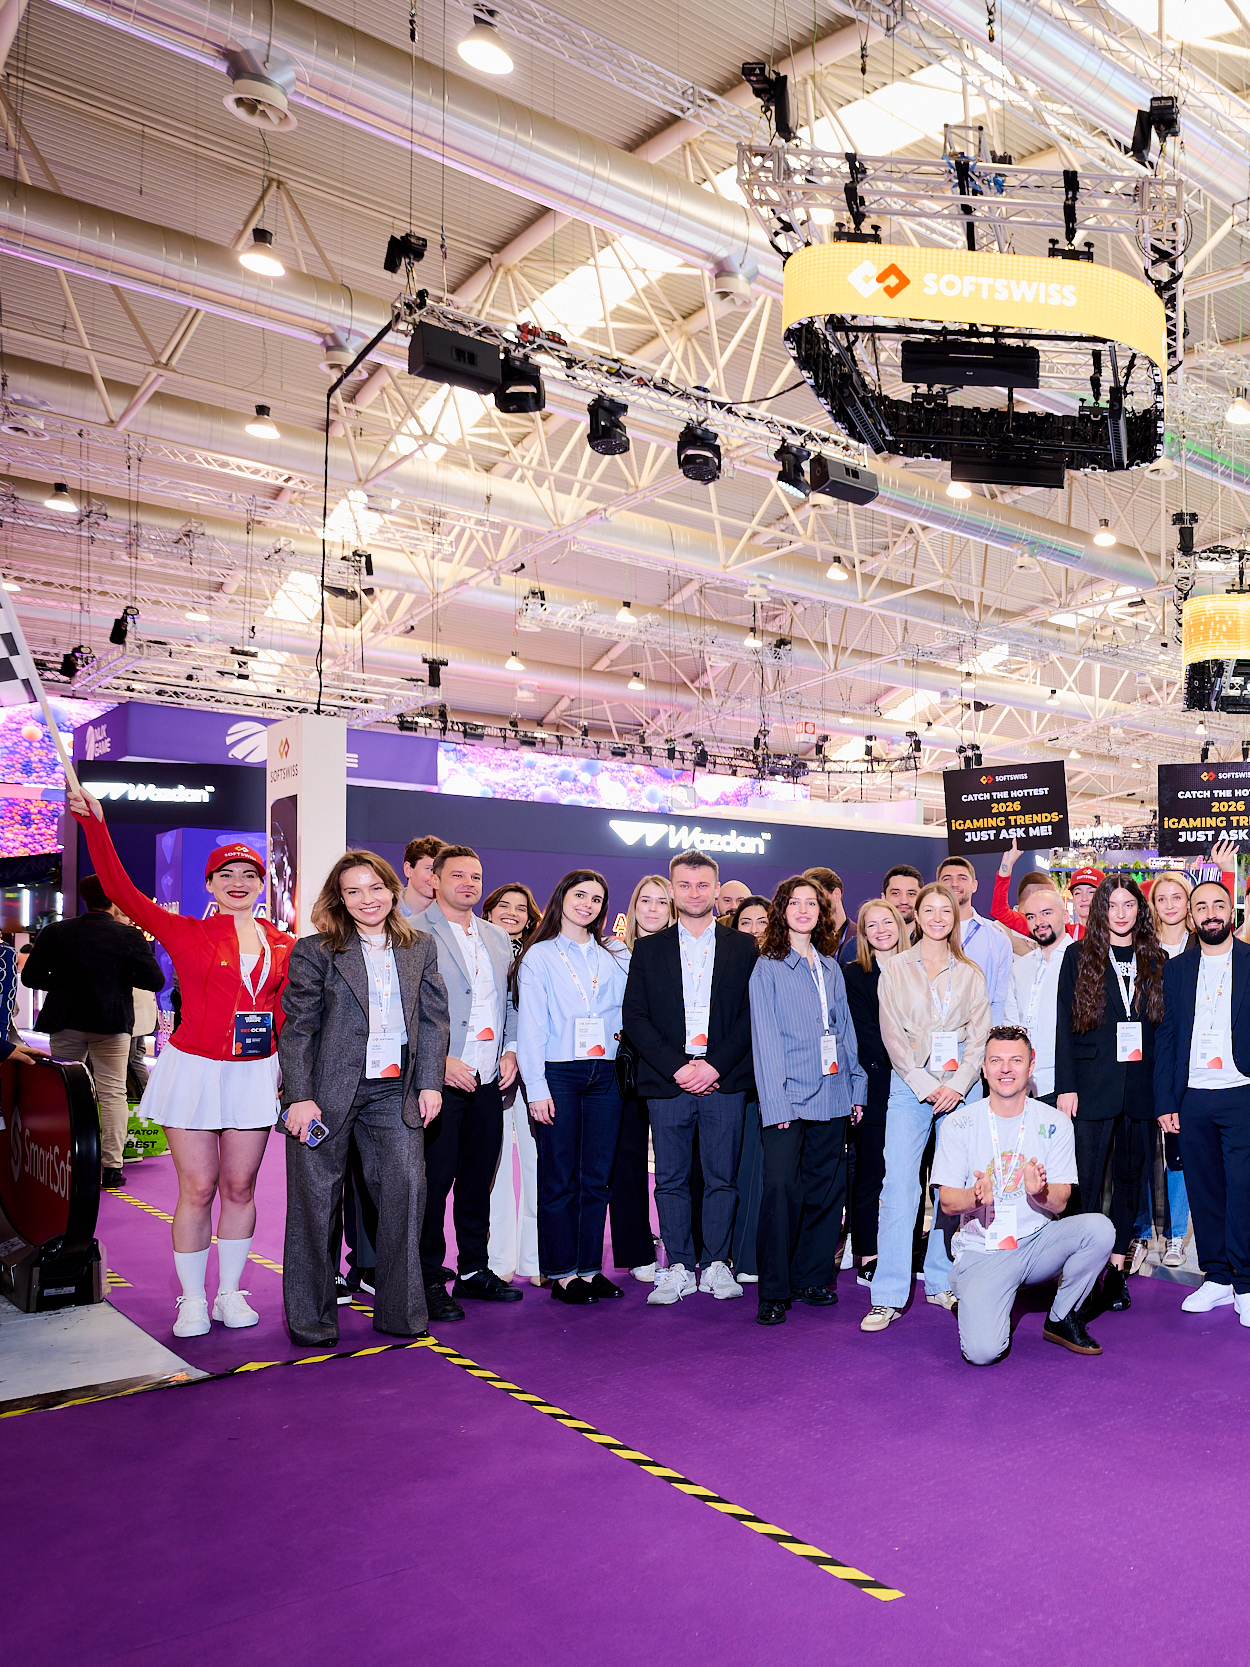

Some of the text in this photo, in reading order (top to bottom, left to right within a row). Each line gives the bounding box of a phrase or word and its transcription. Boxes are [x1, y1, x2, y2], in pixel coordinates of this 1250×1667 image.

[923, 272, 1077, 307] SOFTSWISS
[270, 764, 299, 783] SOFTSWISS
[995, 773, 1028, 782] SOFTSWISS
[128, 782, 210, 803] Wazdan
[961, 787, 1050, 802] CATCH THE HOTTEST
[1177, 790, 1211, 799] CATCH
[1212, 789, 1232, 798] THE
[991, 801, 1021, 814] 2026
[1211, 800, 1246, 813] 2026
[951, 817, 1006, 831] iGAMING
[1163, 816, 1227, 829] iGAMING
[668, 824, 765, 855] Wazdan
[964, 825, 1053, 843] JUST ASK ME!
[1177, 830, 1215, 843] JUST
[1218, 829, 1249, 841] ASK
[126, 1140, 157, 1149] BEST
[24, 1127, 72, 1201] SmartSof
